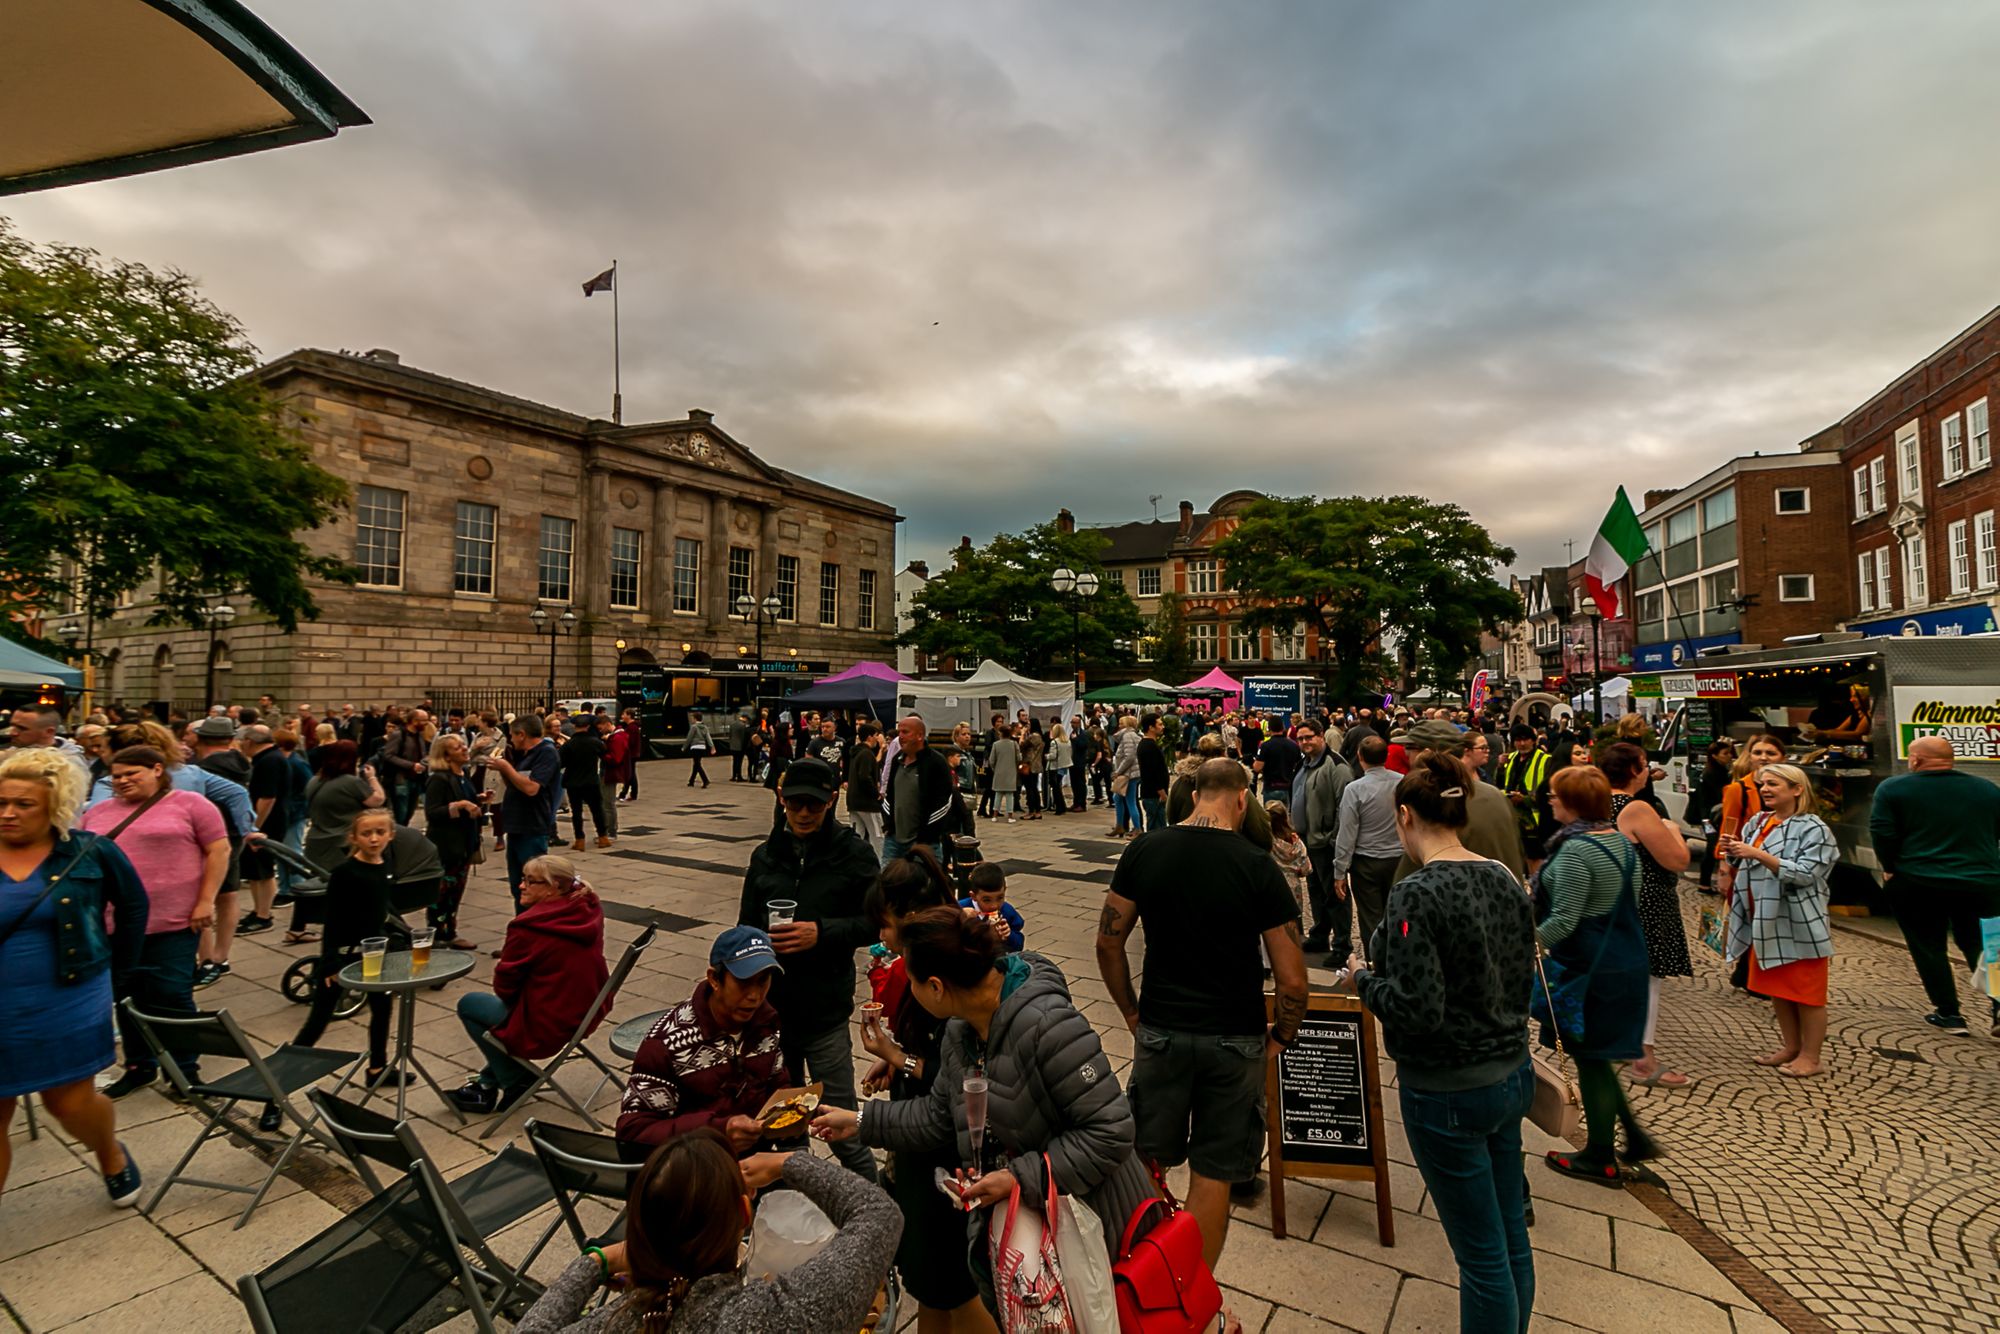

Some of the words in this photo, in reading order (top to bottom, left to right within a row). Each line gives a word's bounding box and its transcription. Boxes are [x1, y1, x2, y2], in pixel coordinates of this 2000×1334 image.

[1249, 682, 1296, 690] MoneyExpert
[1696, 678, 1734, 691] KITCHEN
[1317, 1030, 1355, 1039] SIZZLERS
[1307, 1128, 1342, 1140] £5.00
